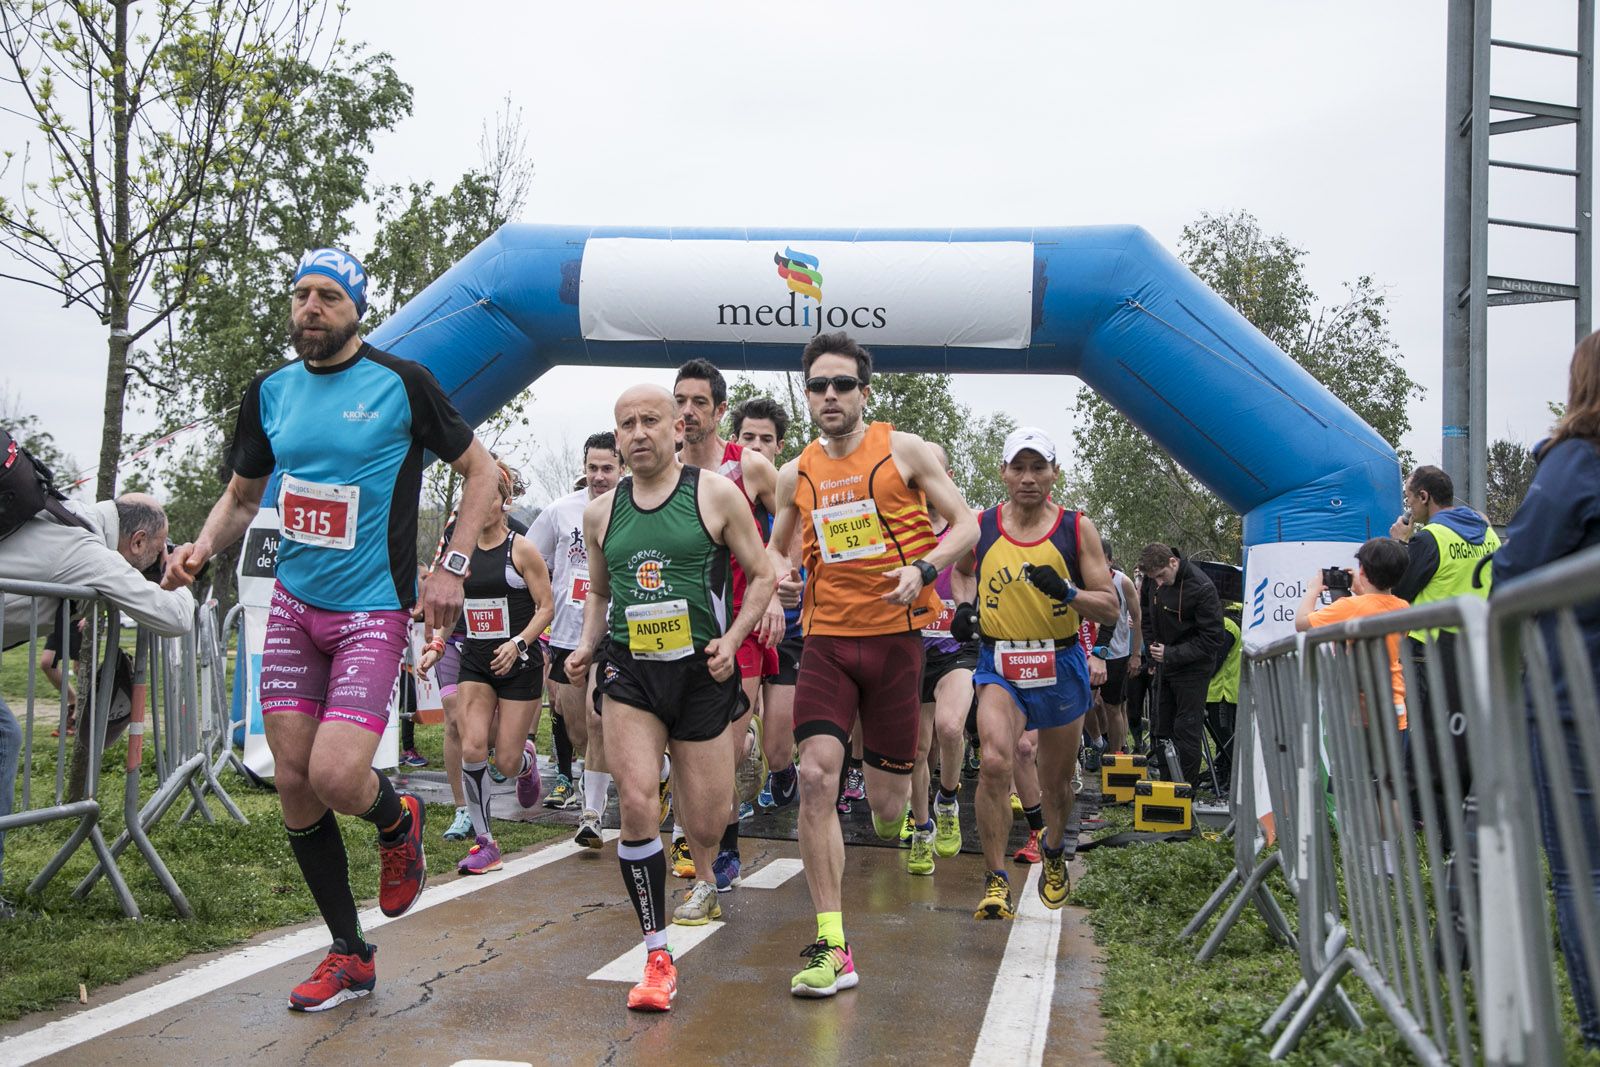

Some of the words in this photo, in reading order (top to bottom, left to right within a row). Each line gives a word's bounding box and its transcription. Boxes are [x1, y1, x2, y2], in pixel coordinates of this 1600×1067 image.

[716, 291, 887, 338] medijocs
[820, 474, 863, 490] Kilometer
[292, 507, 331, 535] 315
[829, 523, 849, 538] JOSE
[850, 519, 871, 531] LUIS
[262, 537, 280, 554] Aju
[846, 535, 860, 548] 52
[257, 554, 271, 567] de
[581, 582, 590, 591] JO
[1273, 581, 1307, 598] Col·
[472, 611, 494, 620] YVETH
[1273, 605, 1294, 622] de
[477, 622, 490, 631] 159
[637, 619, 681, 635] ANDRES
[656, 638, 664, 650] 5
[1008, 655, 1047, 665] SEGUNDO
[1020, 668, 1039, 679] 264
